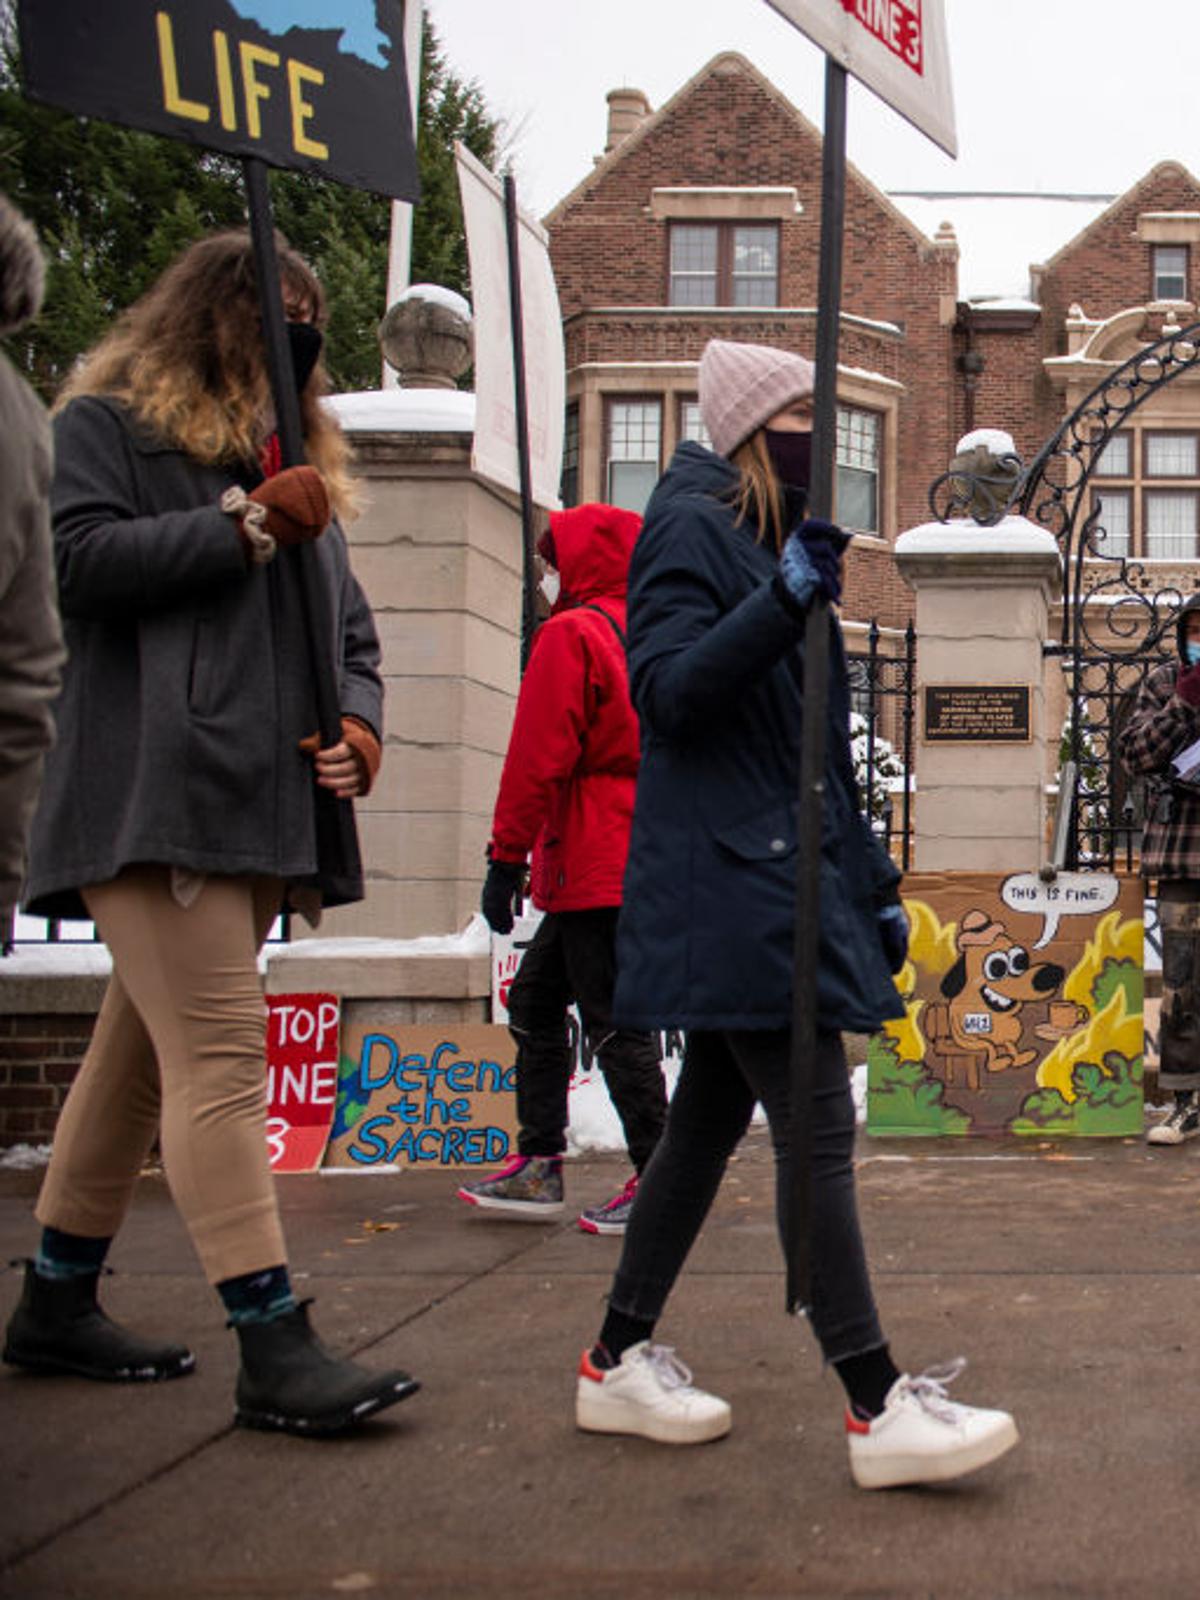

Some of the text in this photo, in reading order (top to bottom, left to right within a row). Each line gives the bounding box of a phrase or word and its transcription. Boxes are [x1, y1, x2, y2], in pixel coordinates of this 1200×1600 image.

[904, 21, 920, 64] 3
[156, 11, 329, 160] LIFE
[1010, 886, 1038, 900] THIS
[1047, 887, 1060, 900] IS
[266, 1002, 340, 1052] TOP
[266, 1062, 338, 1105] INE
[387, 1090, 472, 1125] the
[347, 1115, 509, 1164] SACRED
